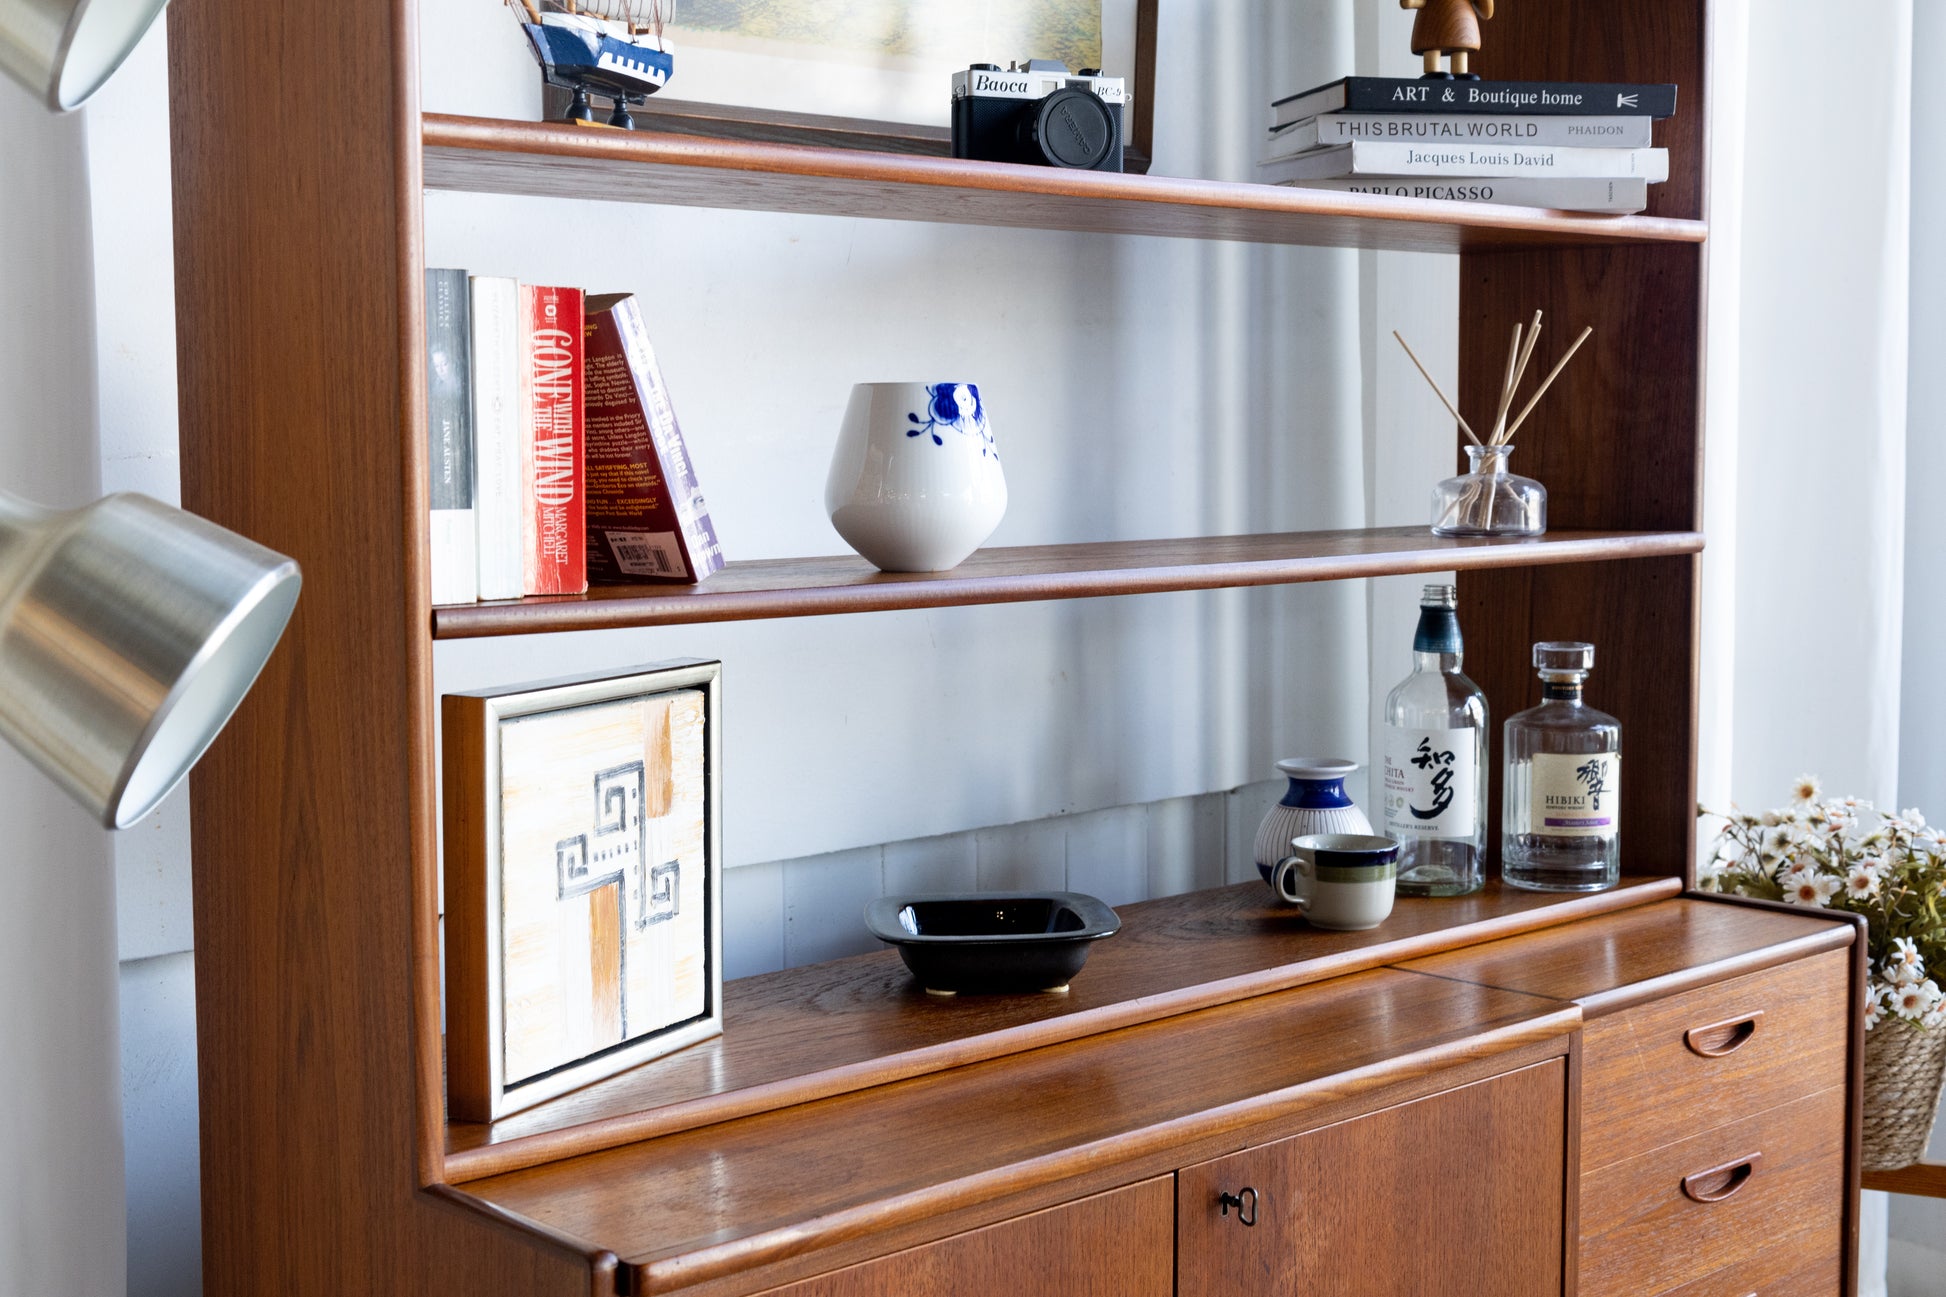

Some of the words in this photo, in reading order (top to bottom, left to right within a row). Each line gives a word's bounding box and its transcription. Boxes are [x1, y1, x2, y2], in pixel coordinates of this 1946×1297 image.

[976, 75, 1028, 93] Baoca
[1392, 86, 1430, 101] ART
[1441, 87, 1455, 102] &
[1468, 88, 1537, 107] Boutique
[1541, 90, 1583, 105] home
[1336, 122, 1383, 136] THIS
[1388, 122, 1463, 136] BRUTAL
[1467, 122, 1538, 137] WORLD
[1567, 126, 1624, 135] PHAIDON
[1406, 150, 1465, 166] Jacques
[1470, 152, 1510, 165] Louis
[1514, 153, 1554, 166] David
[1415, 186, 1493, 200] PICASSO
[531, 329, 573, 403] GONE
[553, 402, 572, 434] WITH
[534, 406, 553, 432] THE
[442, 419, 450, 448] JANE
[443, 448, 451, 484] AUSTEN
[668, 433, 688, 479] VINCI
[533, 436, 574, 505] WIND
[542, 506, 555, 559] MITCHELL
[555, 506, 568, 565] MARGARET
[691, 531, 710, 550] Dan
[1545, 795, 1585, 805] HIBIKI
